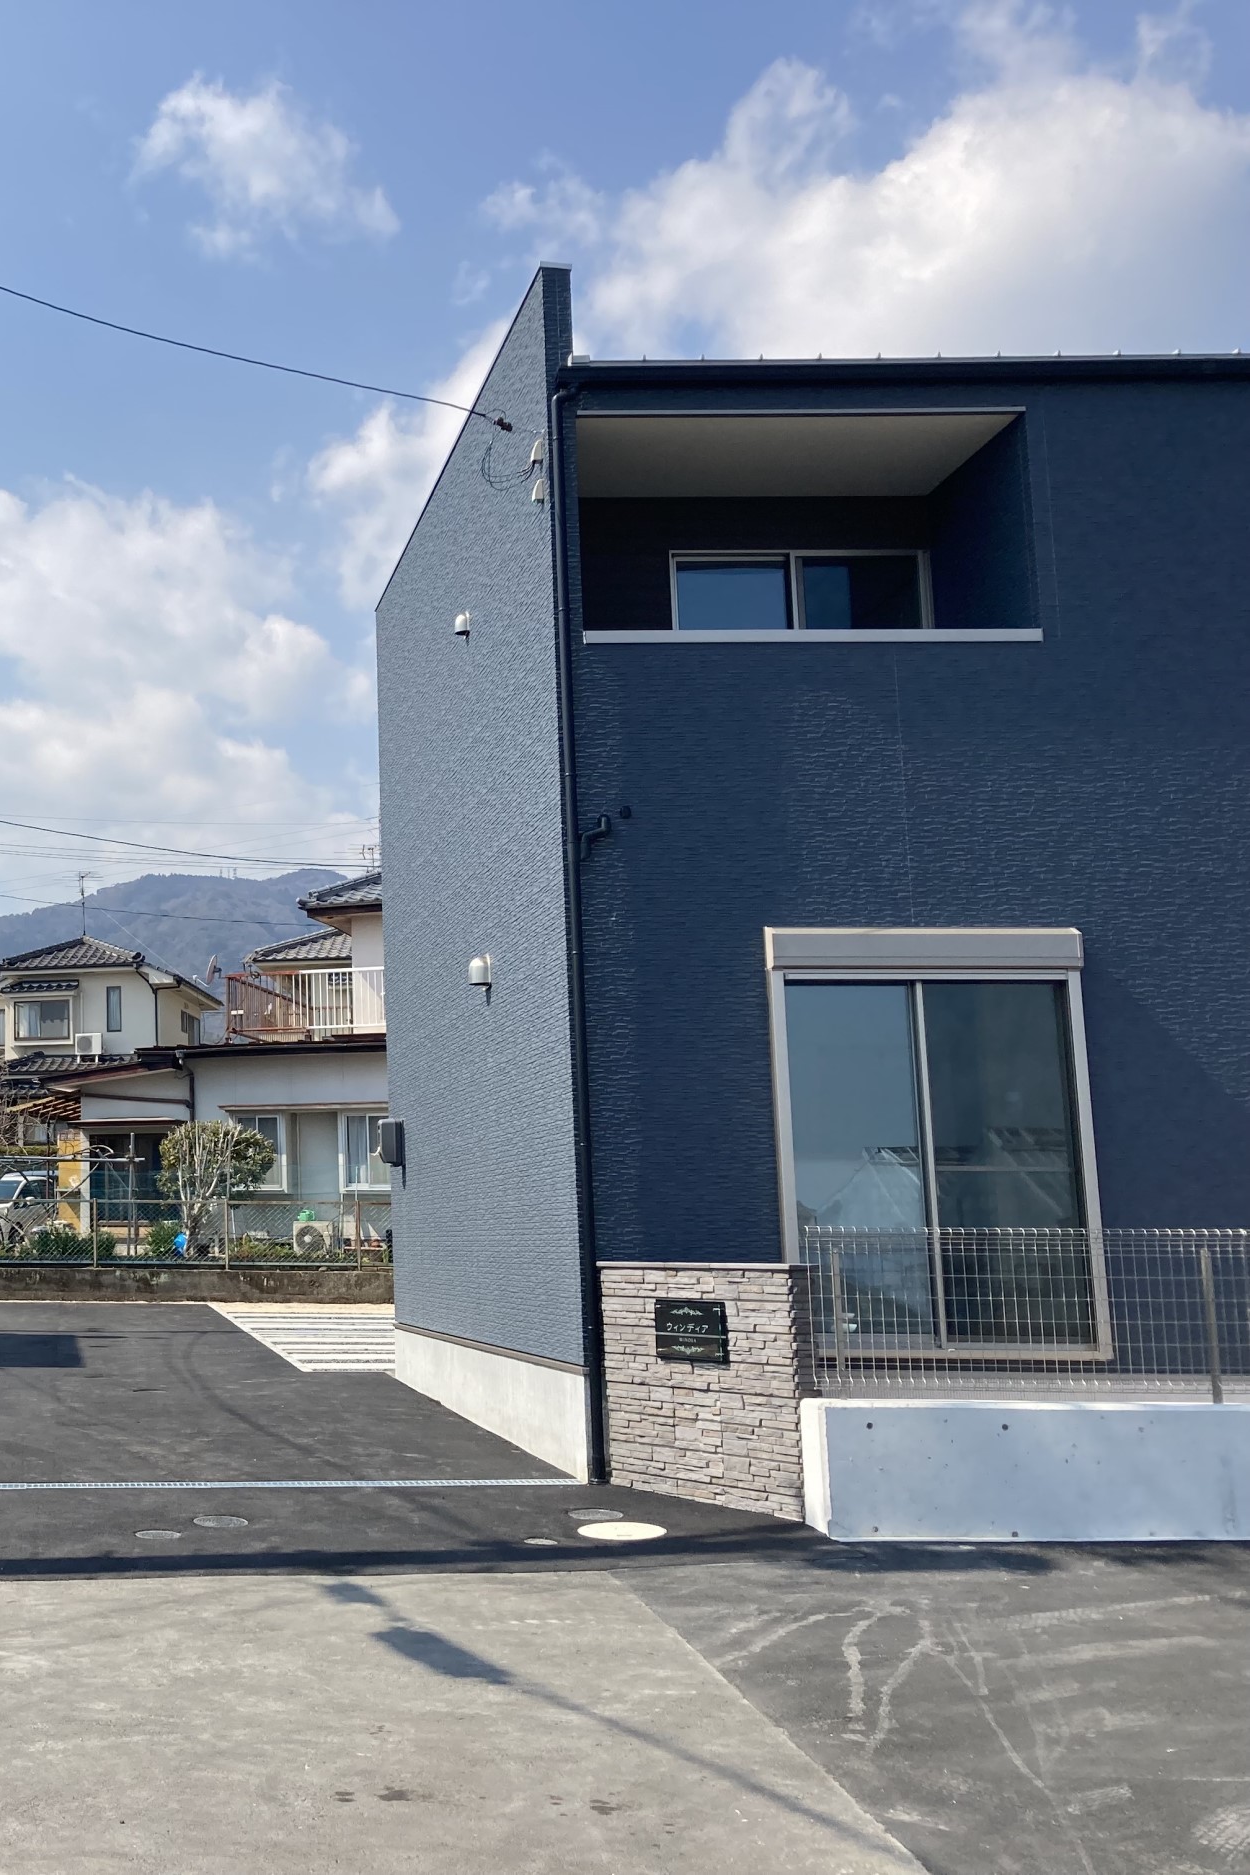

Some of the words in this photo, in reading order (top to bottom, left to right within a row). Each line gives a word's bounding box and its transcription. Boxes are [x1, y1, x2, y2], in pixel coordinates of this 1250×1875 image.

[666, 1322, 709, 1334] ウィンディア
